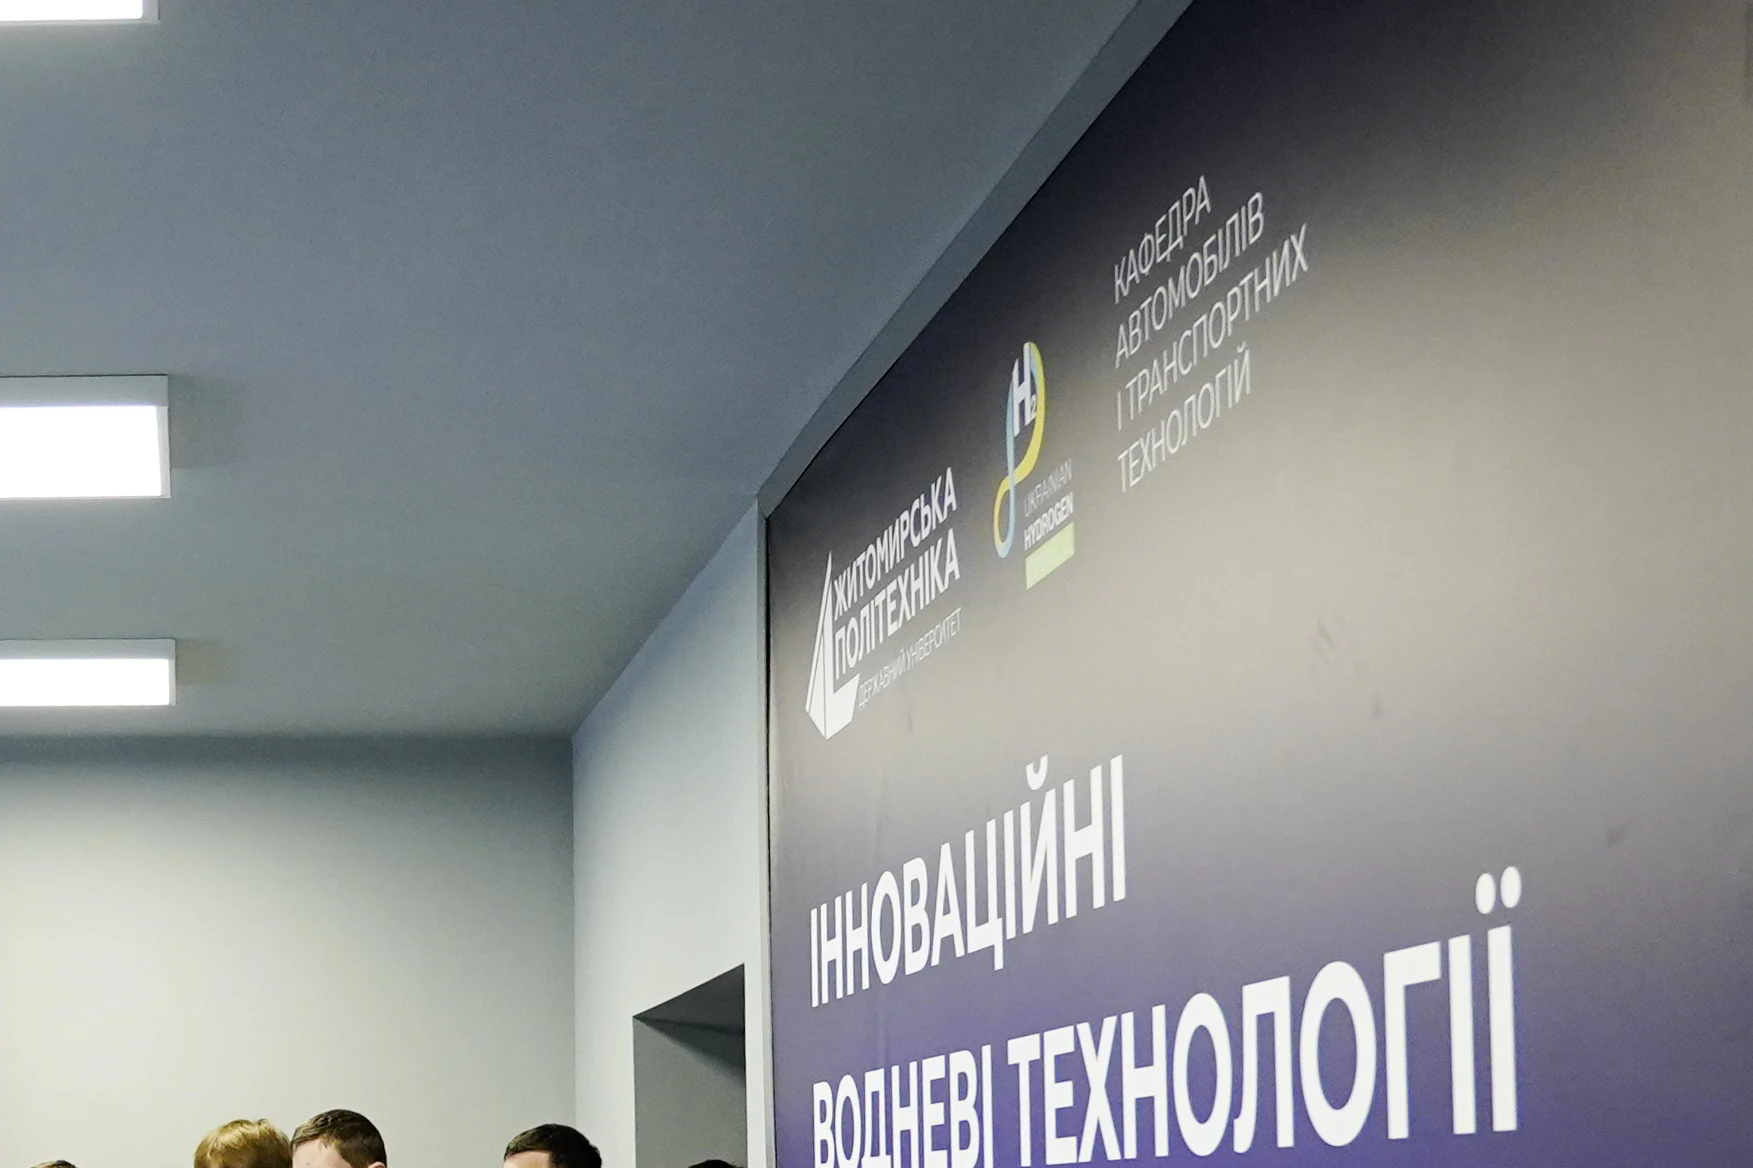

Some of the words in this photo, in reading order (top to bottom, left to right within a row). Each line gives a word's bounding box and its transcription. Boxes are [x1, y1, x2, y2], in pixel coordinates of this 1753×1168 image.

[1114, 175, 1212, 304] КАФЕДРА
[1115, 190, 1265, 369] АВТОМОБІЛІВ
[1116, 390, 1123, 431] І
[1126, 222, 1309, 419] ТРАНСПОРТНИХ
[1117, 340, 1251, 493] ТЕХНОЛОГІЙ
[833, 466, 957, 622] ЖИТОМИРСЬКА
[1023, 490, 1075, 552] HYDROGEN
[835, 527, 961, 678] ПОЛІТЕХНІКА
[810, 754, 1126, 1008] ІННОВАЦІЙНІ
[1007, 865, 1523, 1168] ТЕХНОЛОГІЇ
